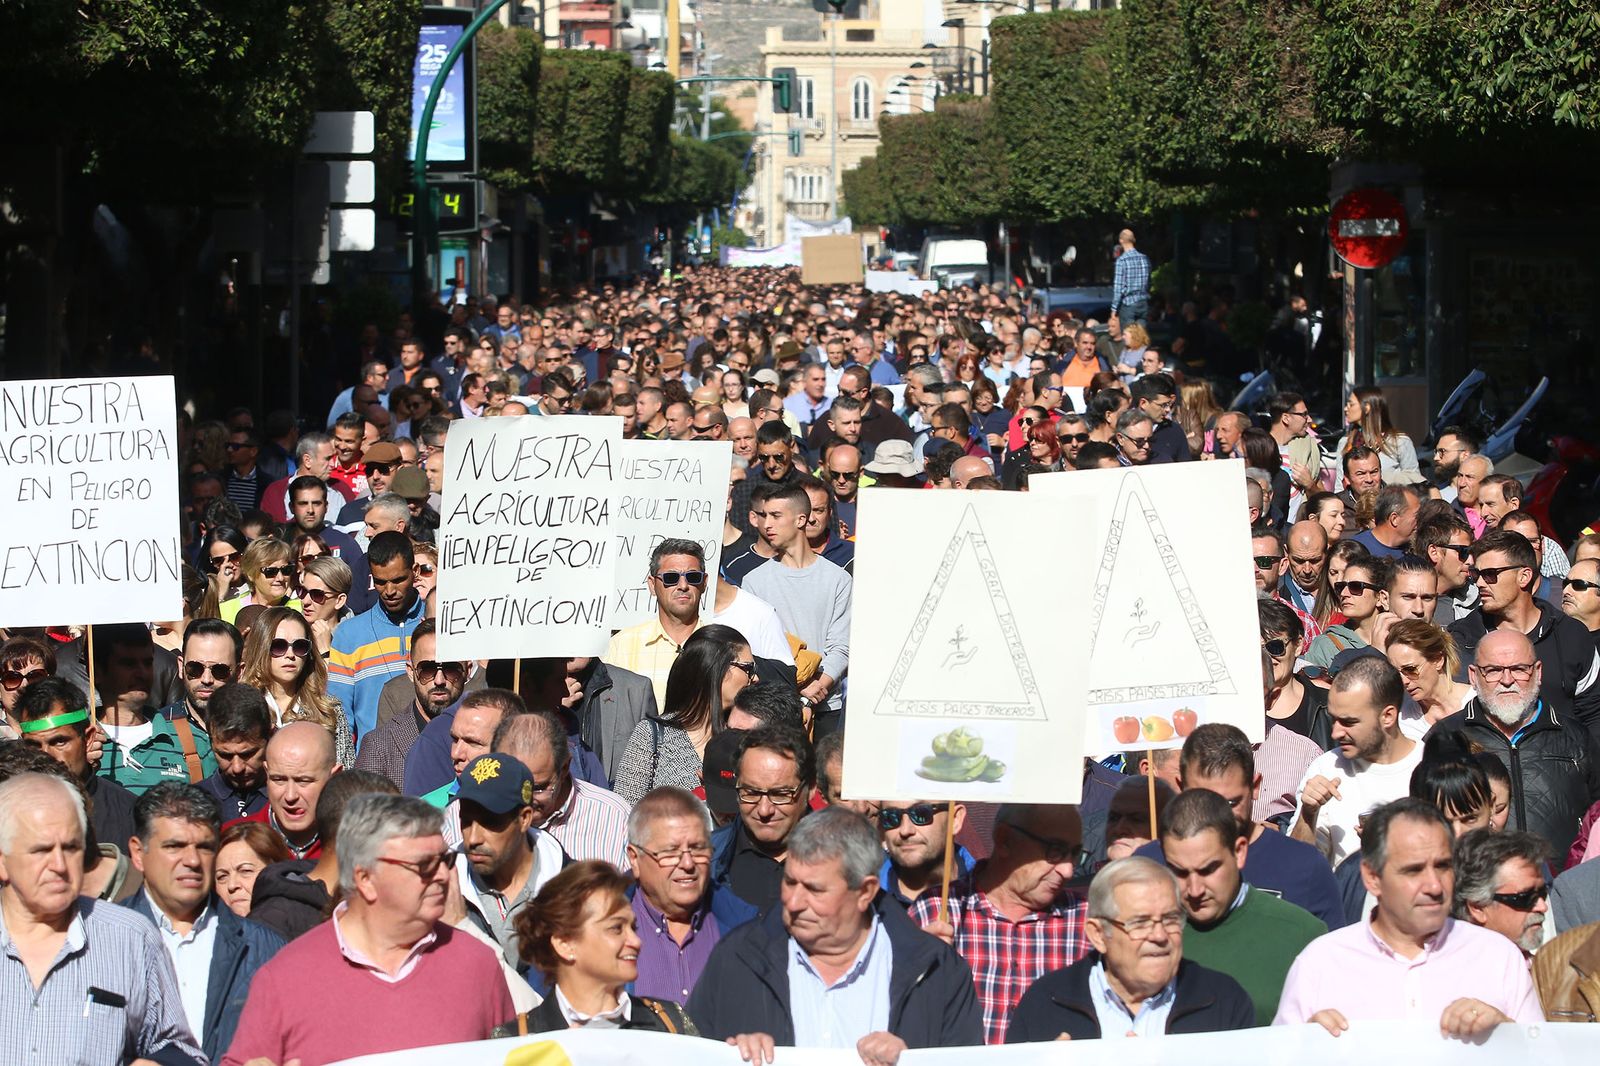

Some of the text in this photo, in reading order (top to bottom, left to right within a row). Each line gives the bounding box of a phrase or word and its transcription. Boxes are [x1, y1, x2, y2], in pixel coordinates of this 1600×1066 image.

[3, 382, 144, 432] NUESTRA
[456, 433, 612, 482] NUESTRA
[620, 457, 702, 485] UESTRA
[18, 471, 151, 501] EN PELIGRO
[72, 508, 99, 529] DE
[617, 496, 712, 523] RICULTURA
[616, 535, 636, 557] N
[1102, 519, 1124, 571] EUROPA
[1143, 509, 1158, 523] LA
[1155, 534, 1181, 576] GRAN
[1, 537, 178, 589] EXTINCION
[516, 567, 547, 583] DE
